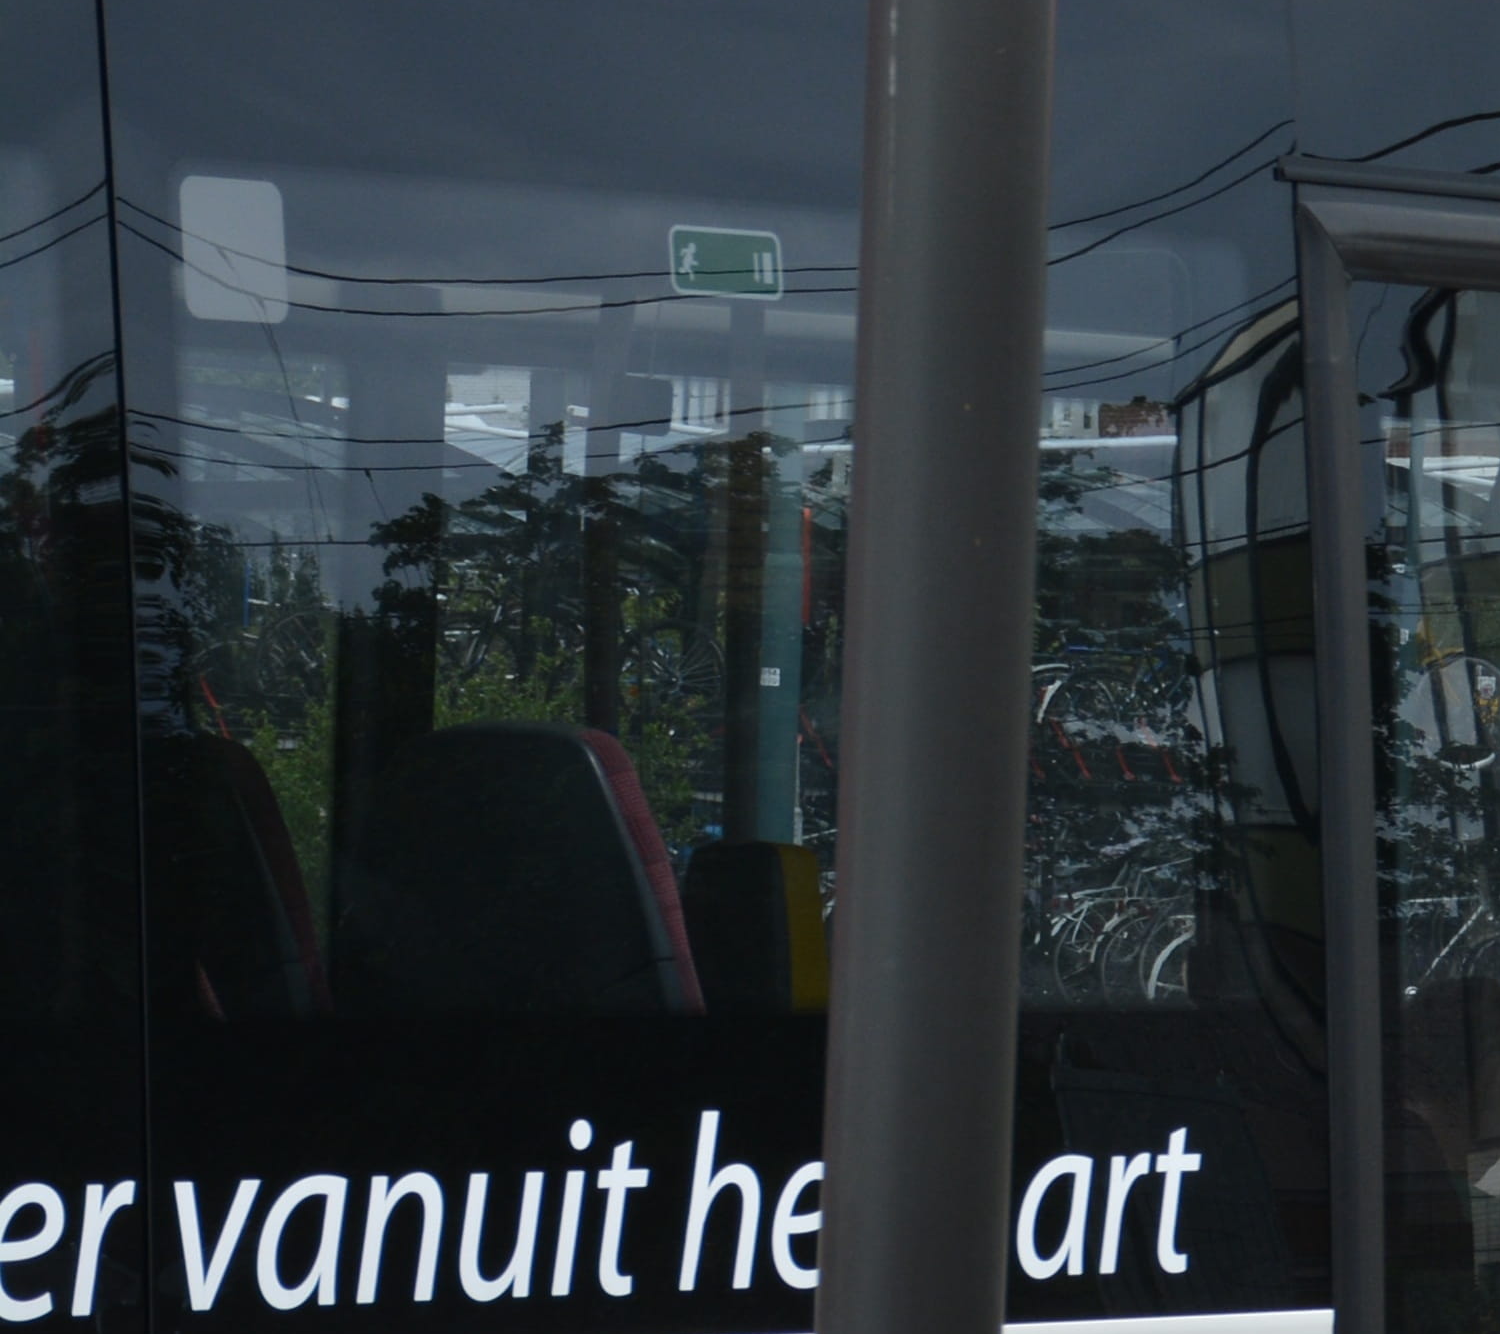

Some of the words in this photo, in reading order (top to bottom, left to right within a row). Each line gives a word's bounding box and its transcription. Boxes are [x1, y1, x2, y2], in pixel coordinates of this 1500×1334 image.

[173, 1118, 650, 1313] vanuit
[678, 1110, 823, 1292] he
[1016, 1126, 1201, 1280] art
